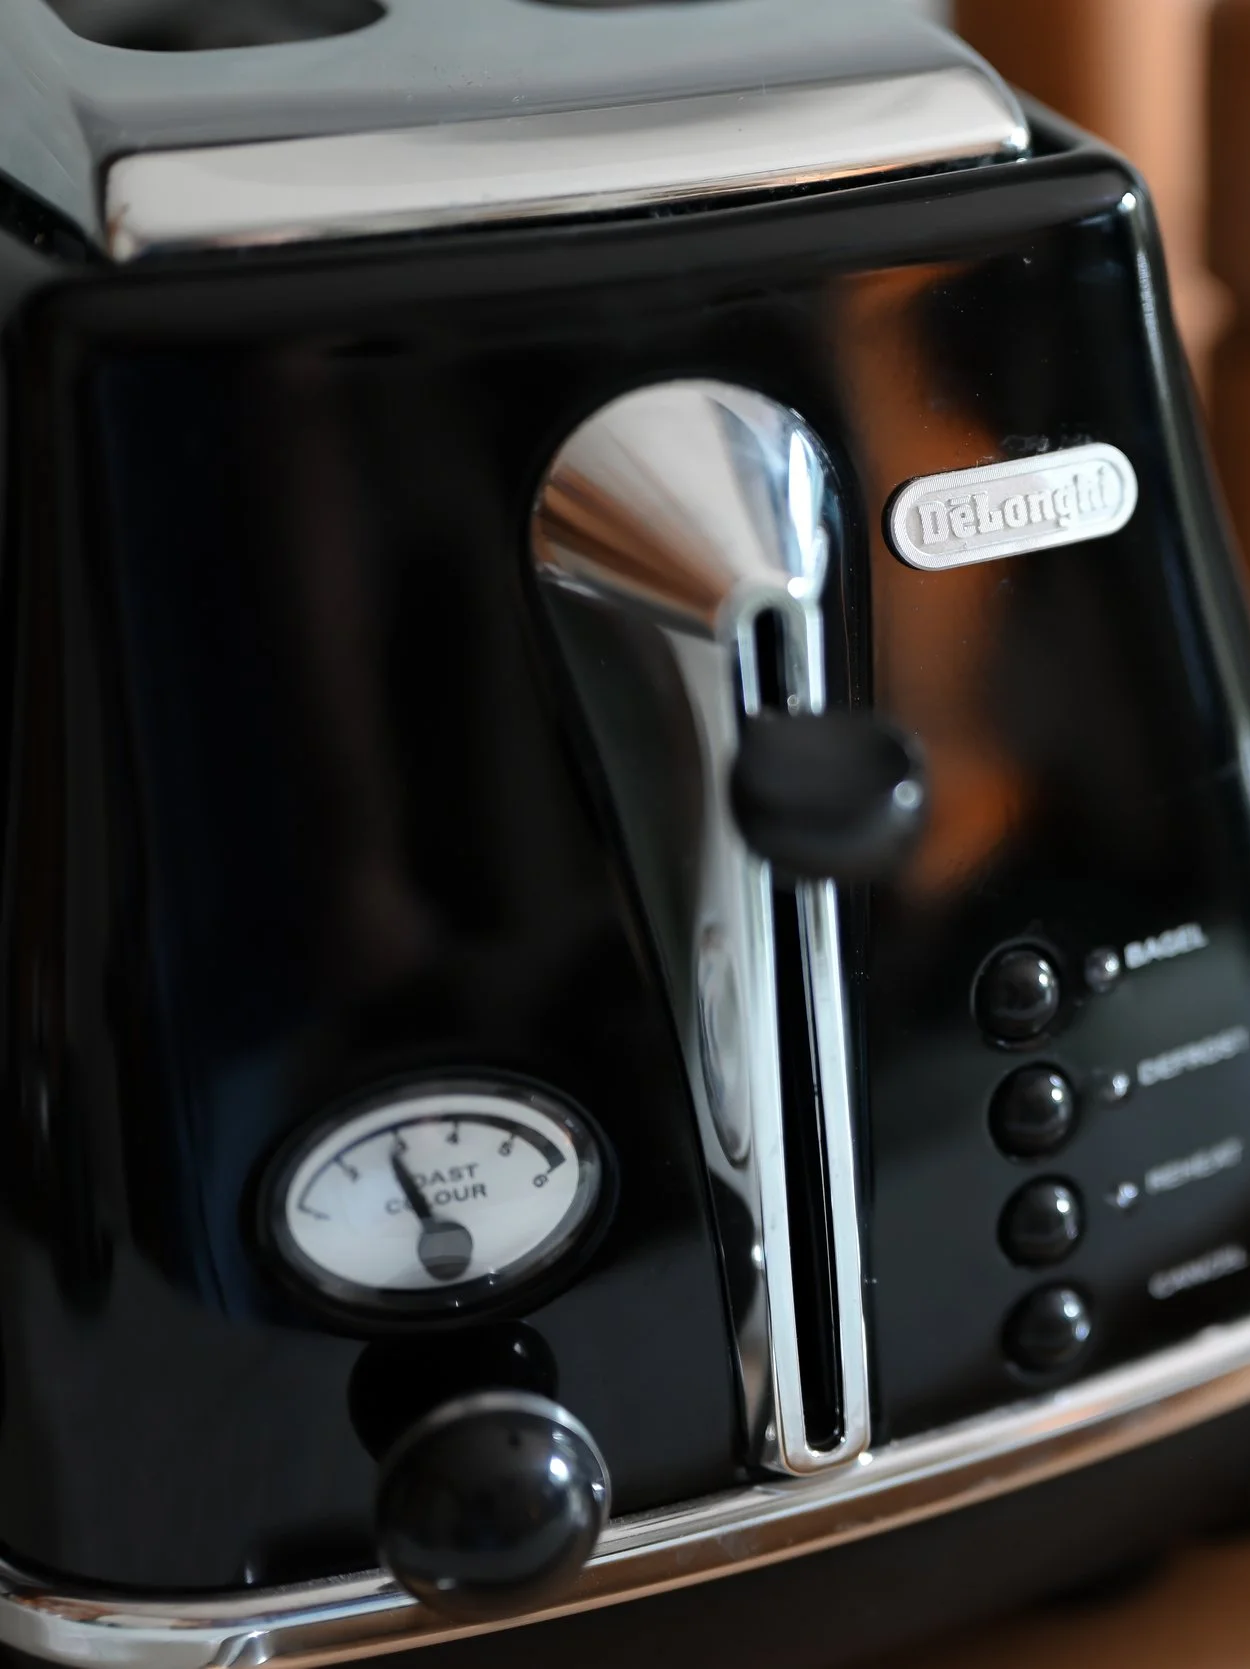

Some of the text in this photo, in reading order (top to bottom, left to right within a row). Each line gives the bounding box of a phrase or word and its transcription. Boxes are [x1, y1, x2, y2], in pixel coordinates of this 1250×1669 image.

[1124, 922, 1209, 969] BAGEL
[447, 1131, 459, 1145] 4
[499, 1141, 511, 1157] 5
[407, 1162, 479, 1188] OAST
[532, 1174, 549, 1189] 6
